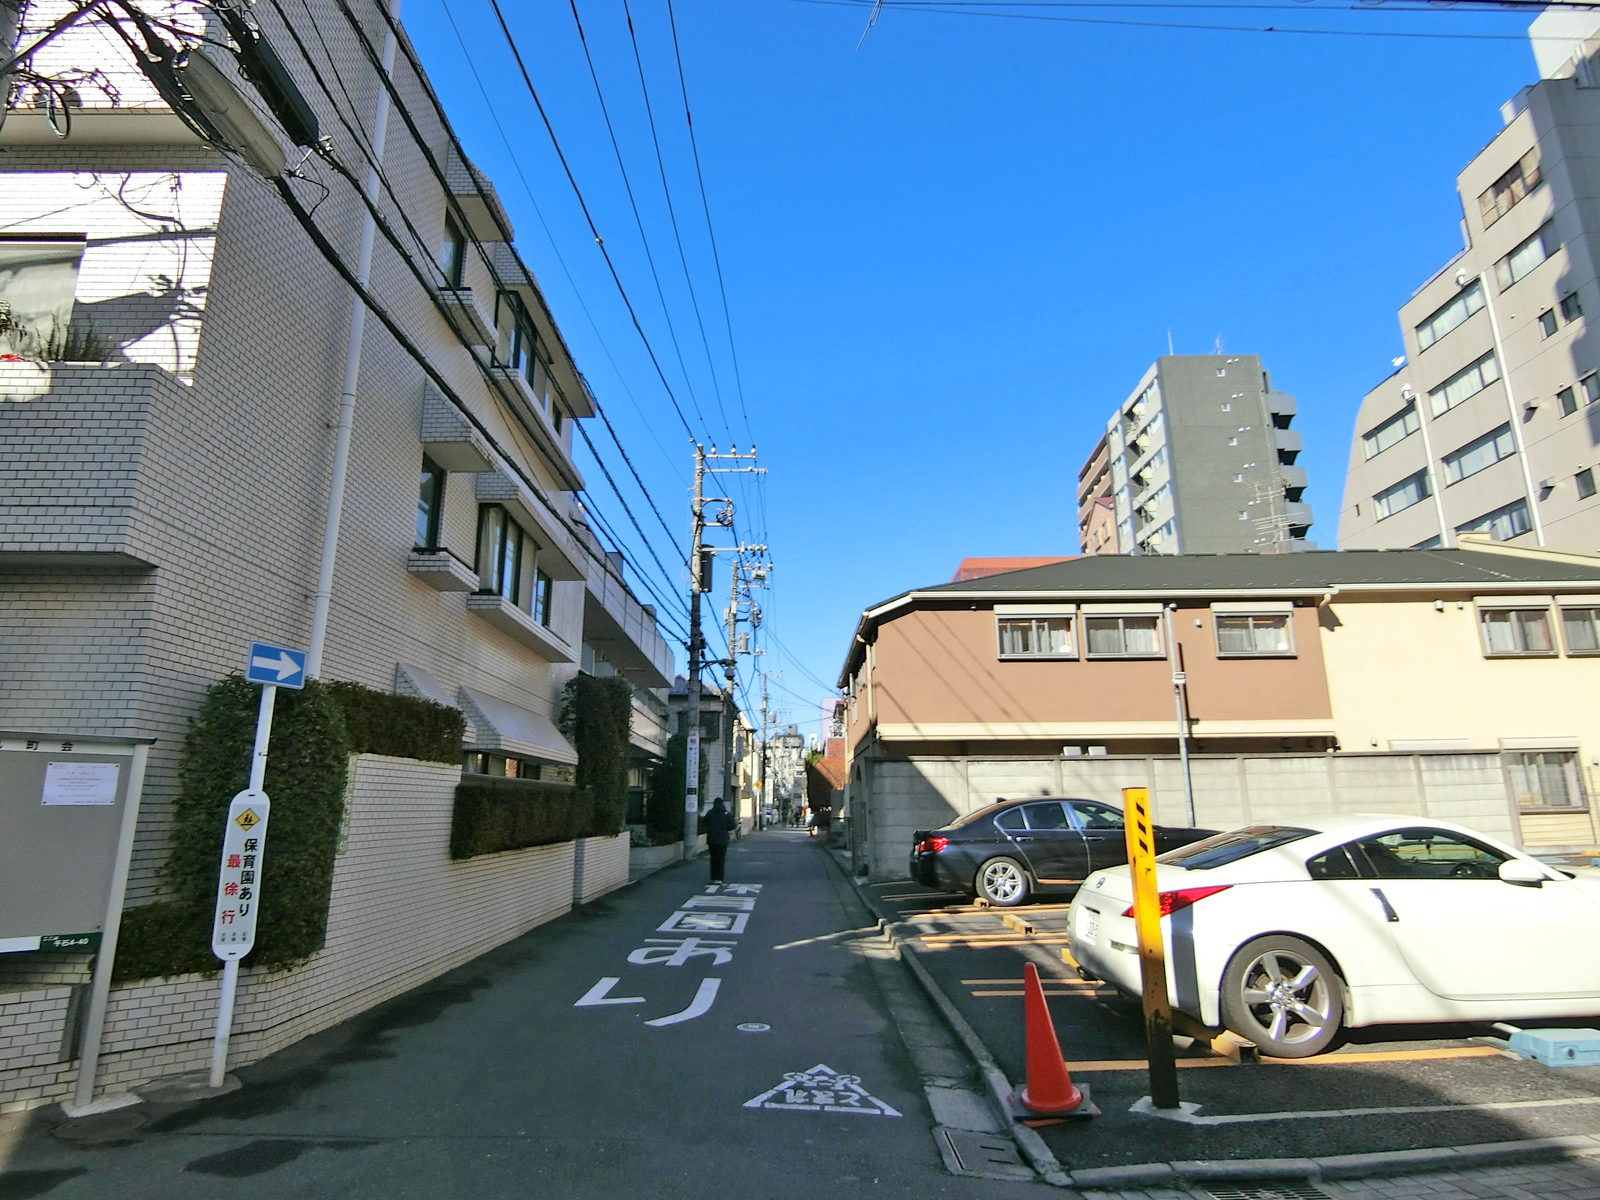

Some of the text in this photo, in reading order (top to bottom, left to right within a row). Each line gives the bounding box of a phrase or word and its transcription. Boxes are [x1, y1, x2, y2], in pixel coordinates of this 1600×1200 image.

[221, 854, 241, 925] 最徐行
[239, 838, 258, 918] 保育園あり
[573, 883, 764, 1027] 保育園あり
